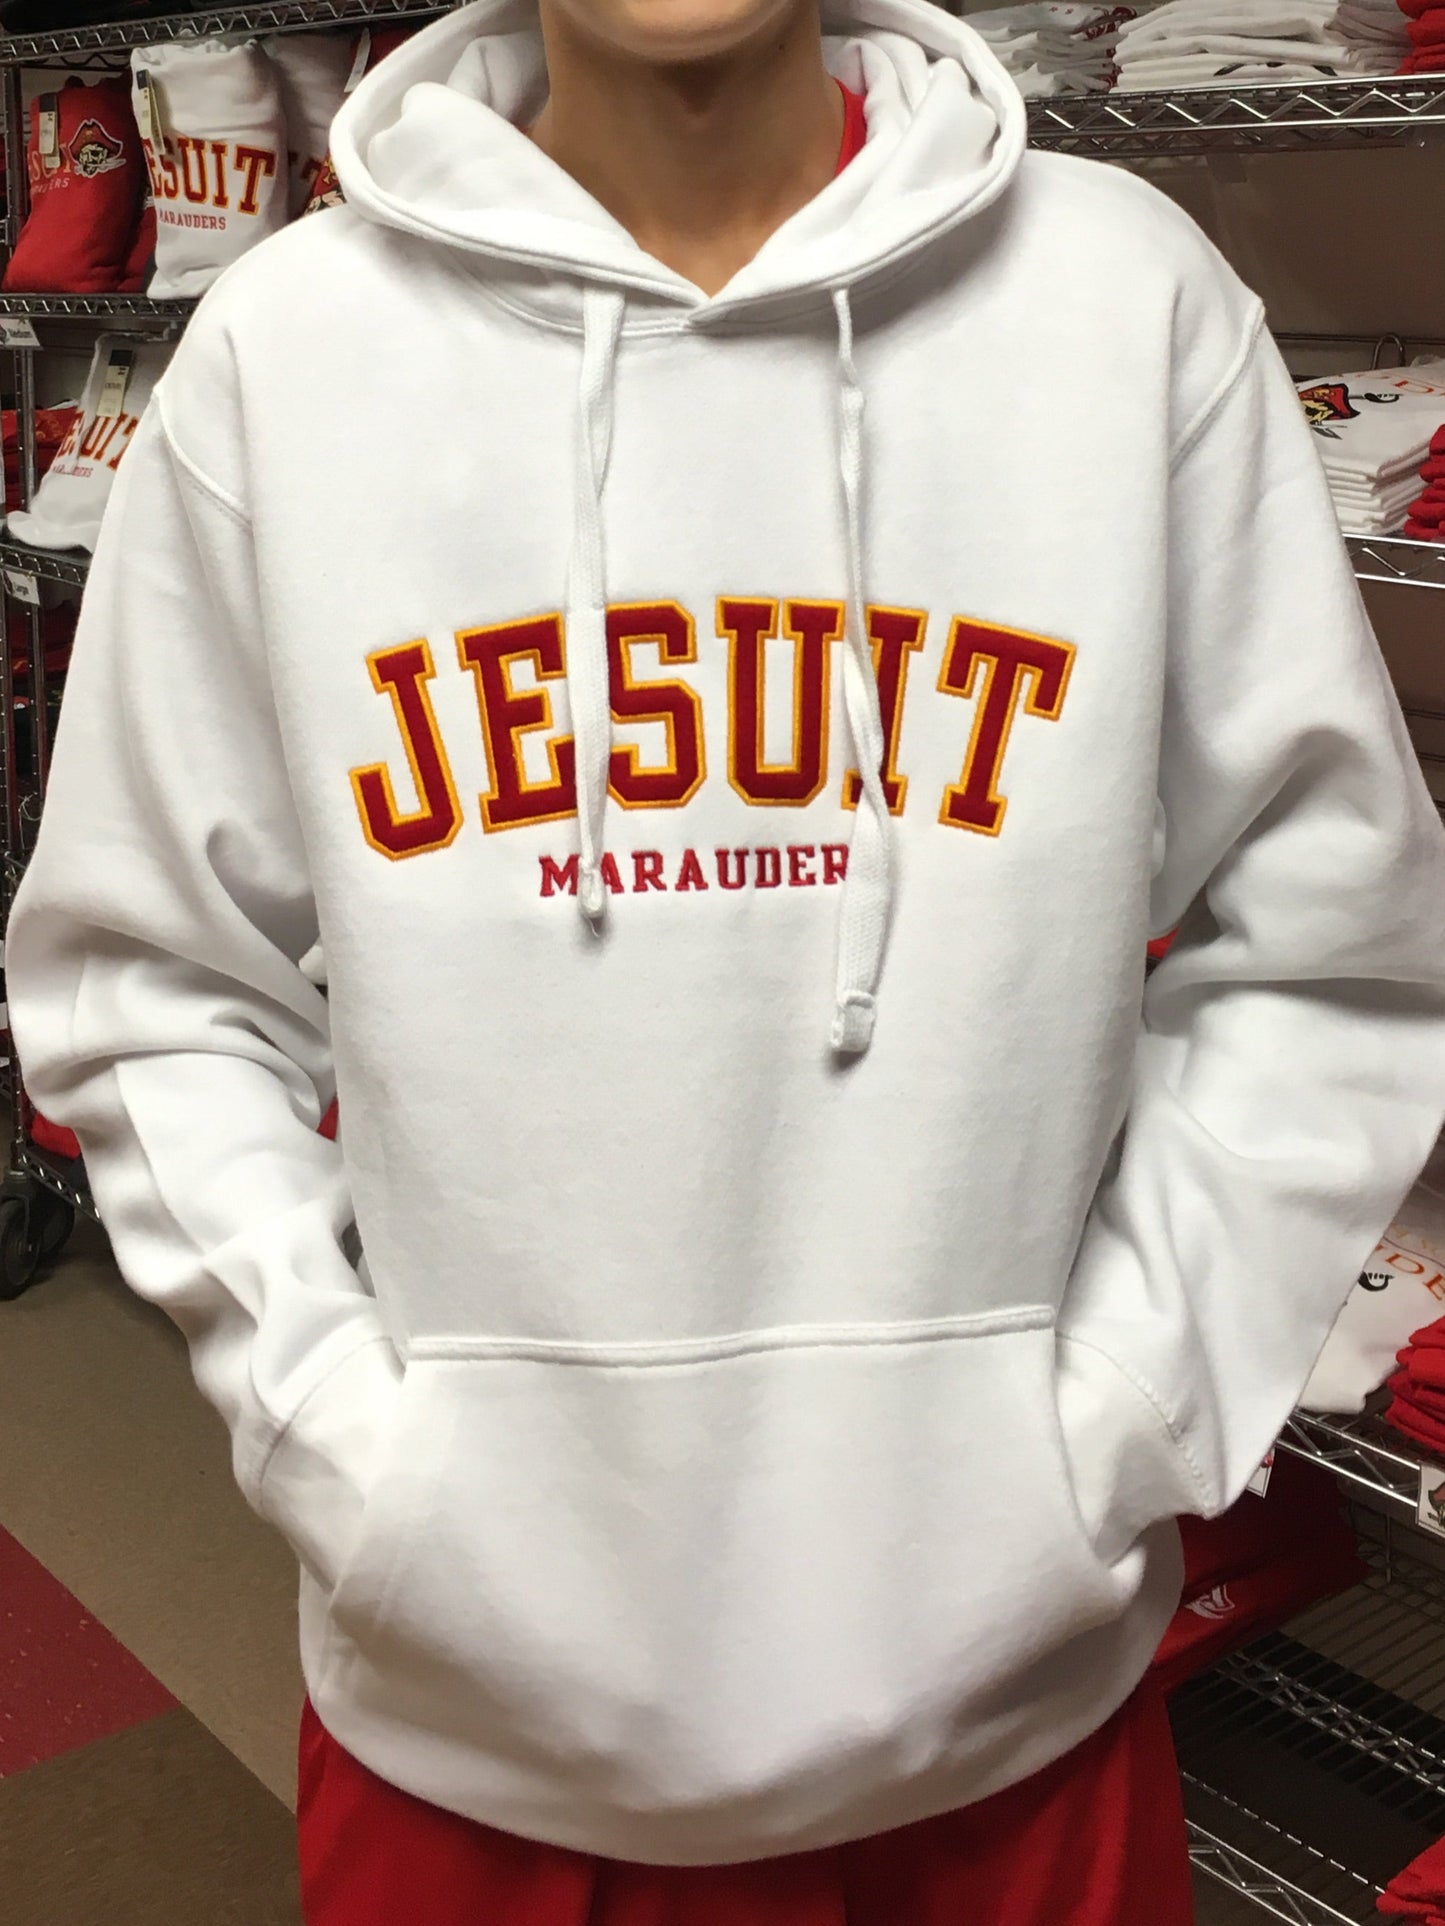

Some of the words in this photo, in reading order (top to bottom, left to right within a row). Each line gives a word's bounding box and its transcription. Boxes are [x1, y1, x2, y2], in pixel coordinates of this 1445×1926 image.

[141, 135, 277, 217] ESUIT
[350, 595, 1077, 861] JESUIT
[539, 843, 849, 897] MARAUDER
